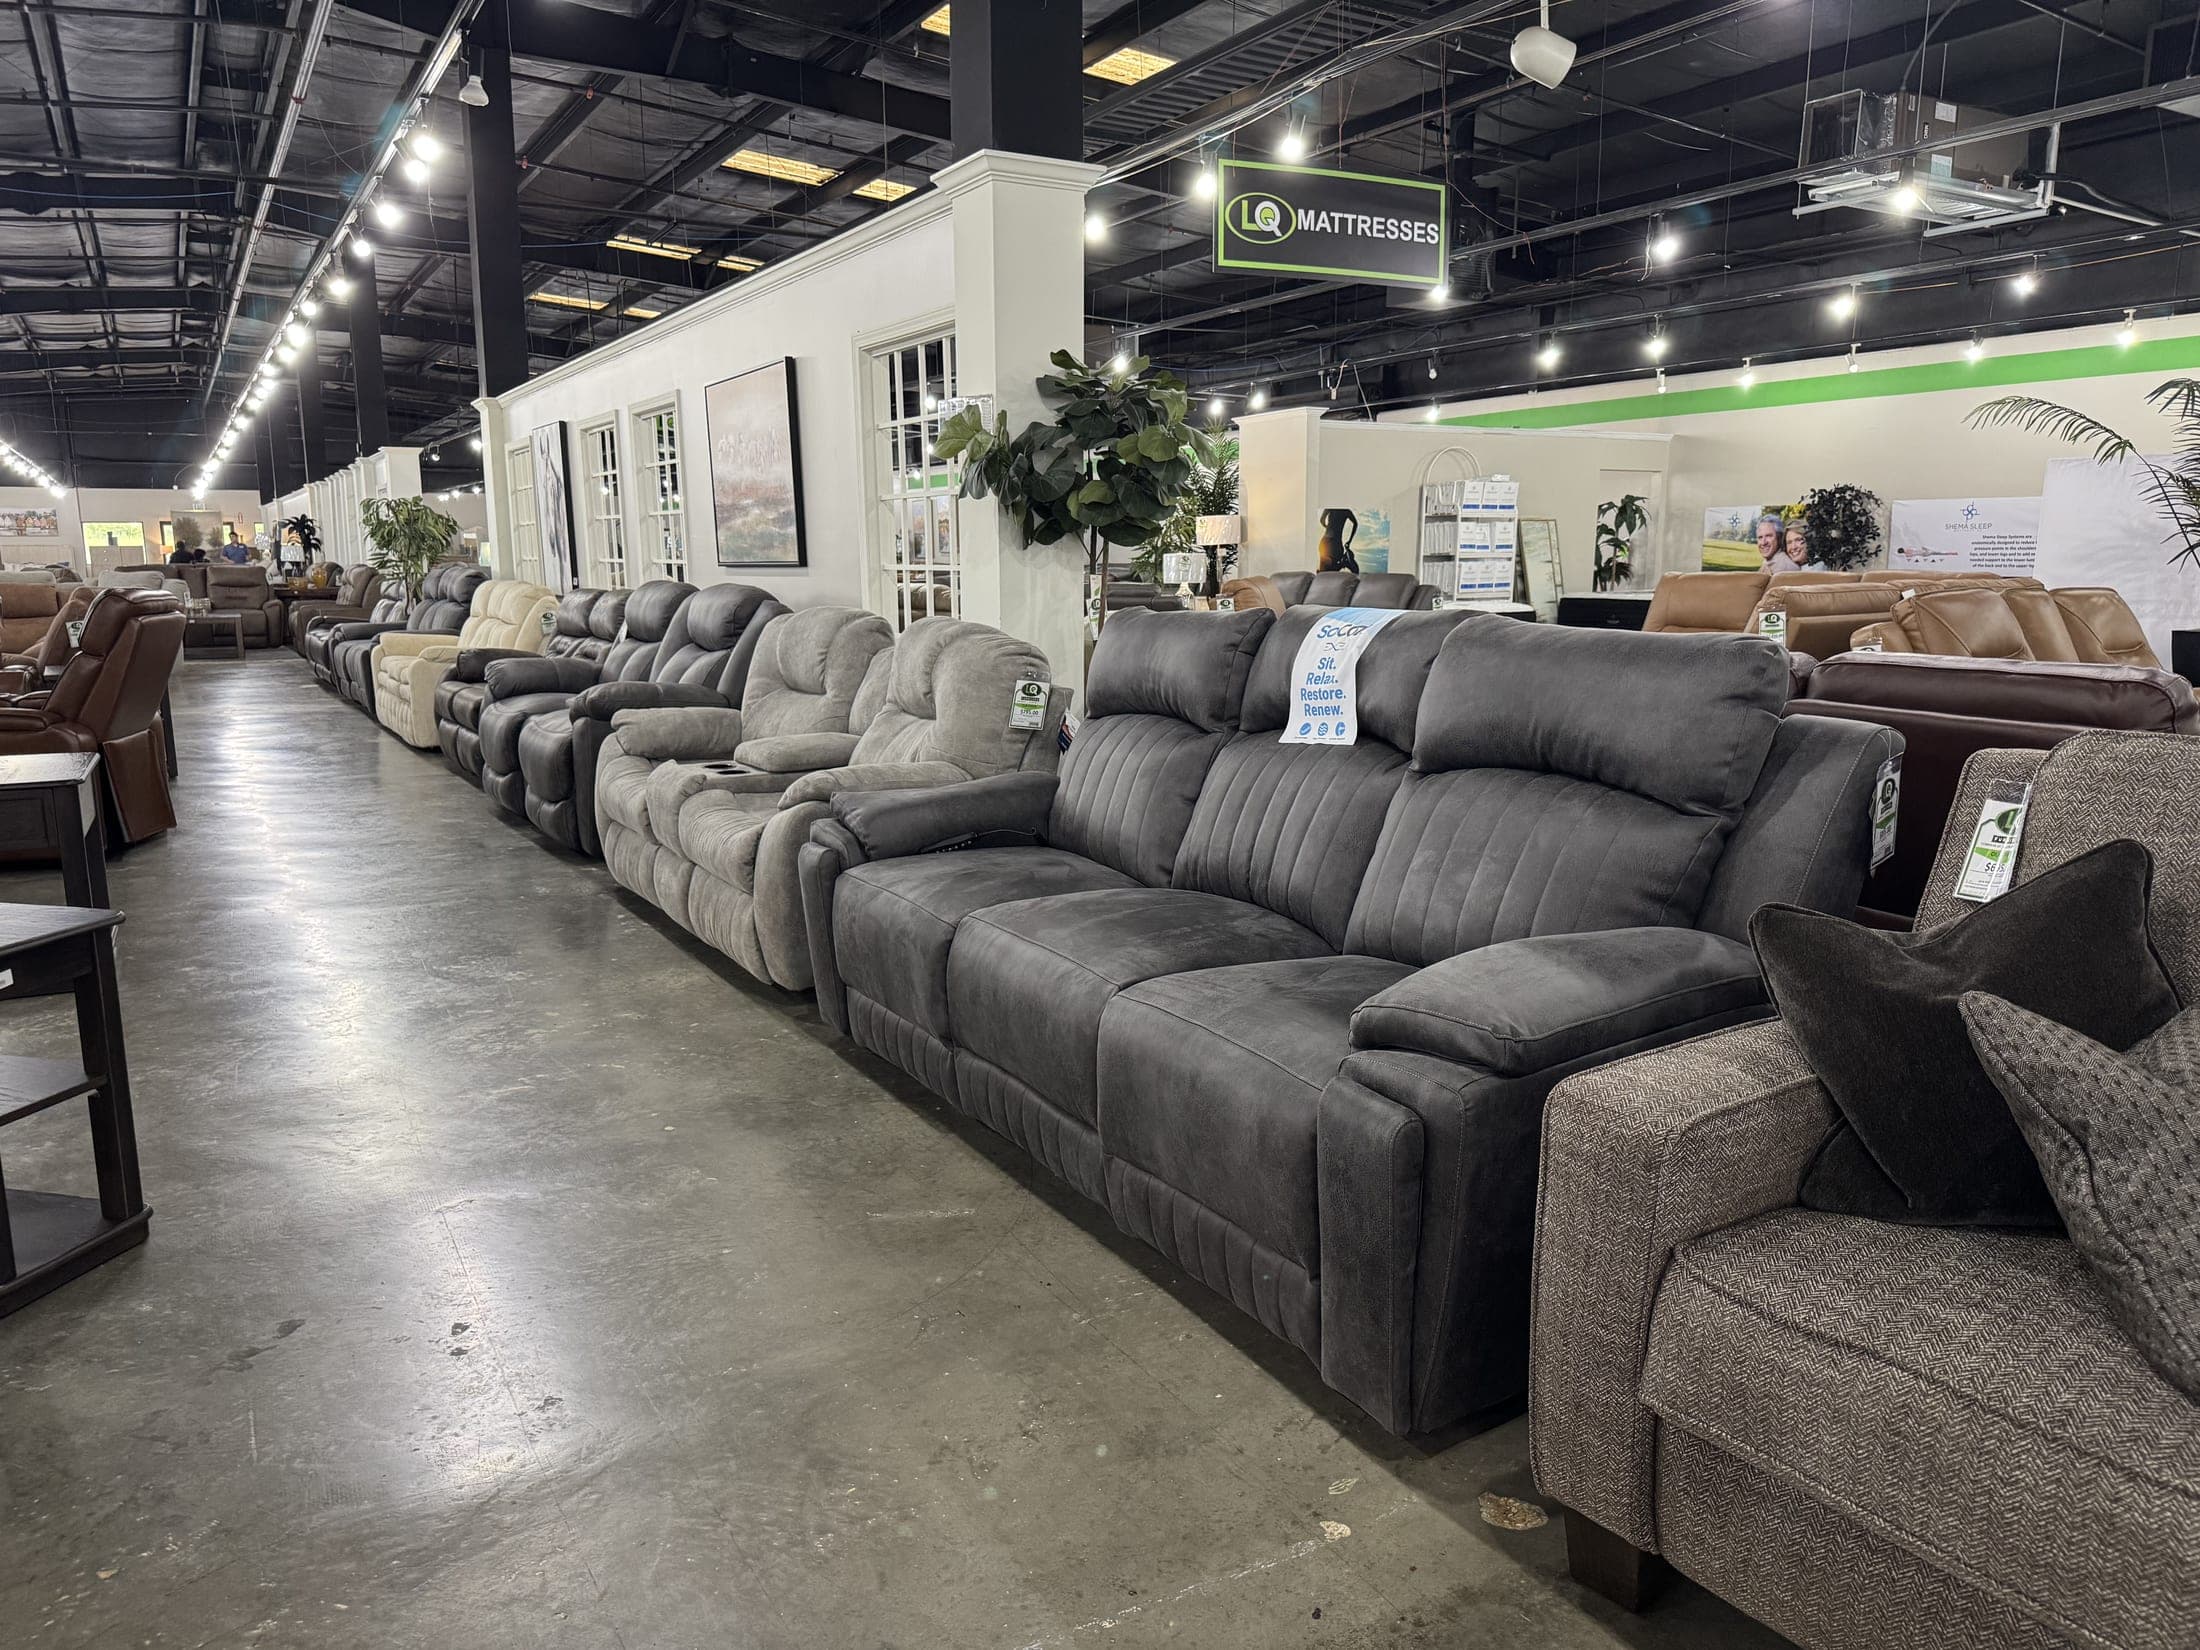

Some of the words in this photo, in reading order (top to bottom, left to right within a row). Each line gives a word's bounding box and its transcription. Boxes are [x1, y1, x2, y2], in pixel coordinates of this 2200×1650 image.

[1241, 199, 1282, 237] LQ
[1297, 209, 1439, 244] MATTRESSES
[1317, 656, 1336, 670] Sit.
[1300, 688, 1346, 702] Restore.
[1304, 704, 1344, 717] Renew.
